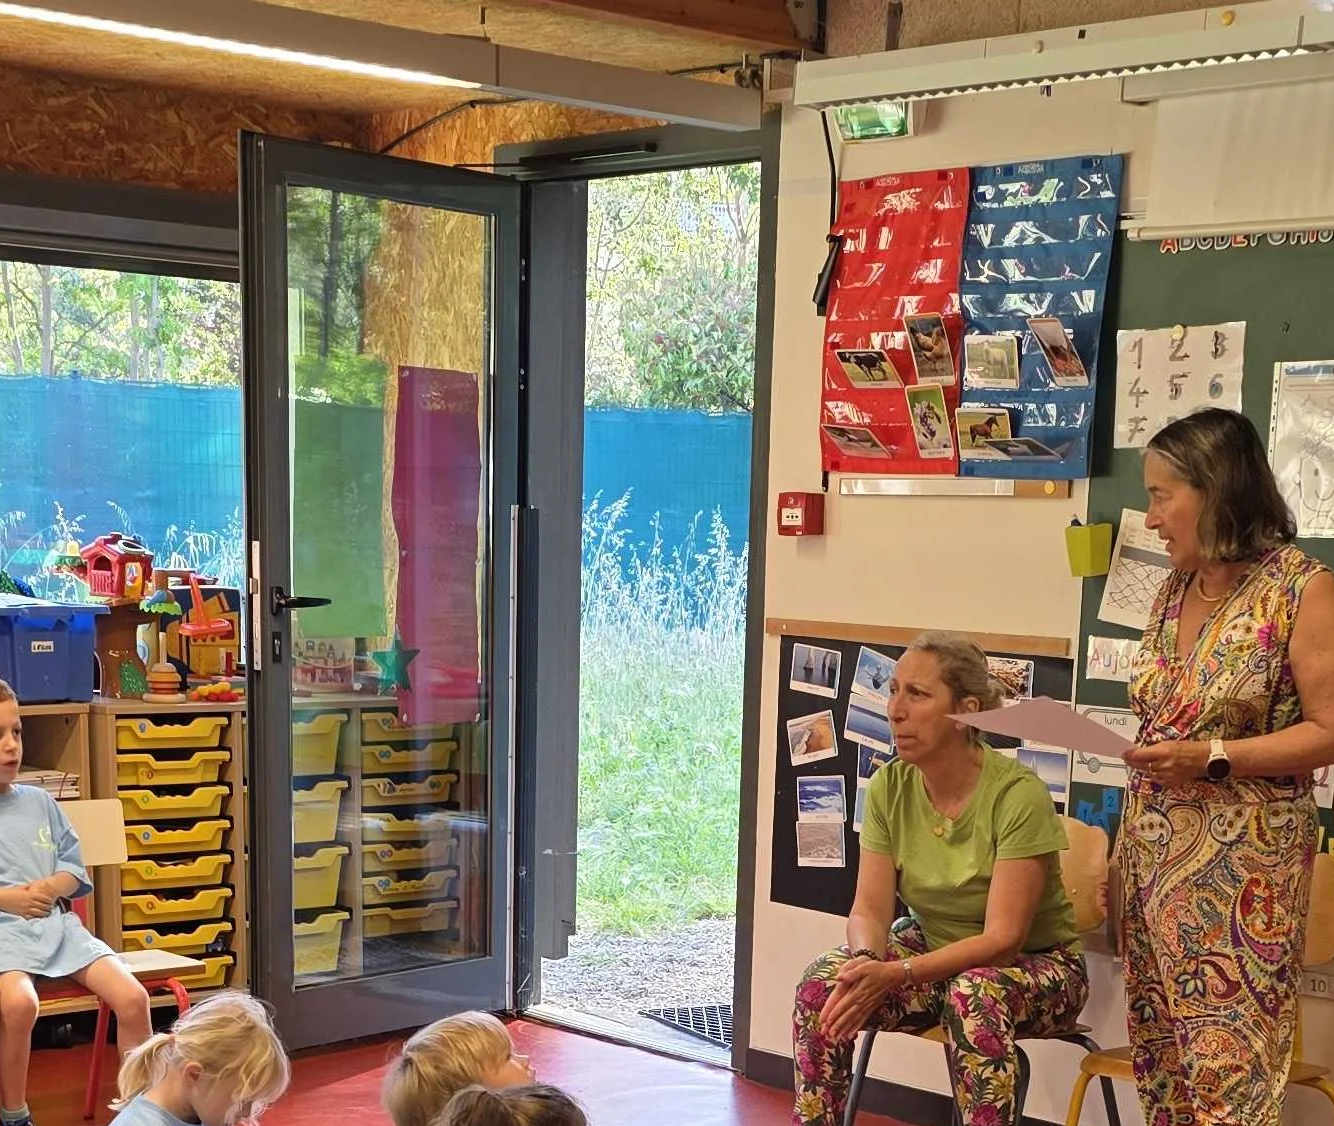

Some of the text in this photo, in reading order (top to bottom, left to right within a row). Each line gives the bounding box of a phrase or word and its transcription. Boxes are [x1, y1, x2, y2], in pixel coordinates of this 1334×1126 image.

[1129, 337, 1143, 369] 1
[1169, 338, 1190, 361] 2
[1128, 371, 1224, 408] 4 5 6
[1127, 416, 1148, 442] 7
[1104, 714, 1127, 727] lundi
[1107, 796, 1115, 807] 2
[1309, 978, 1327, 993] 10
